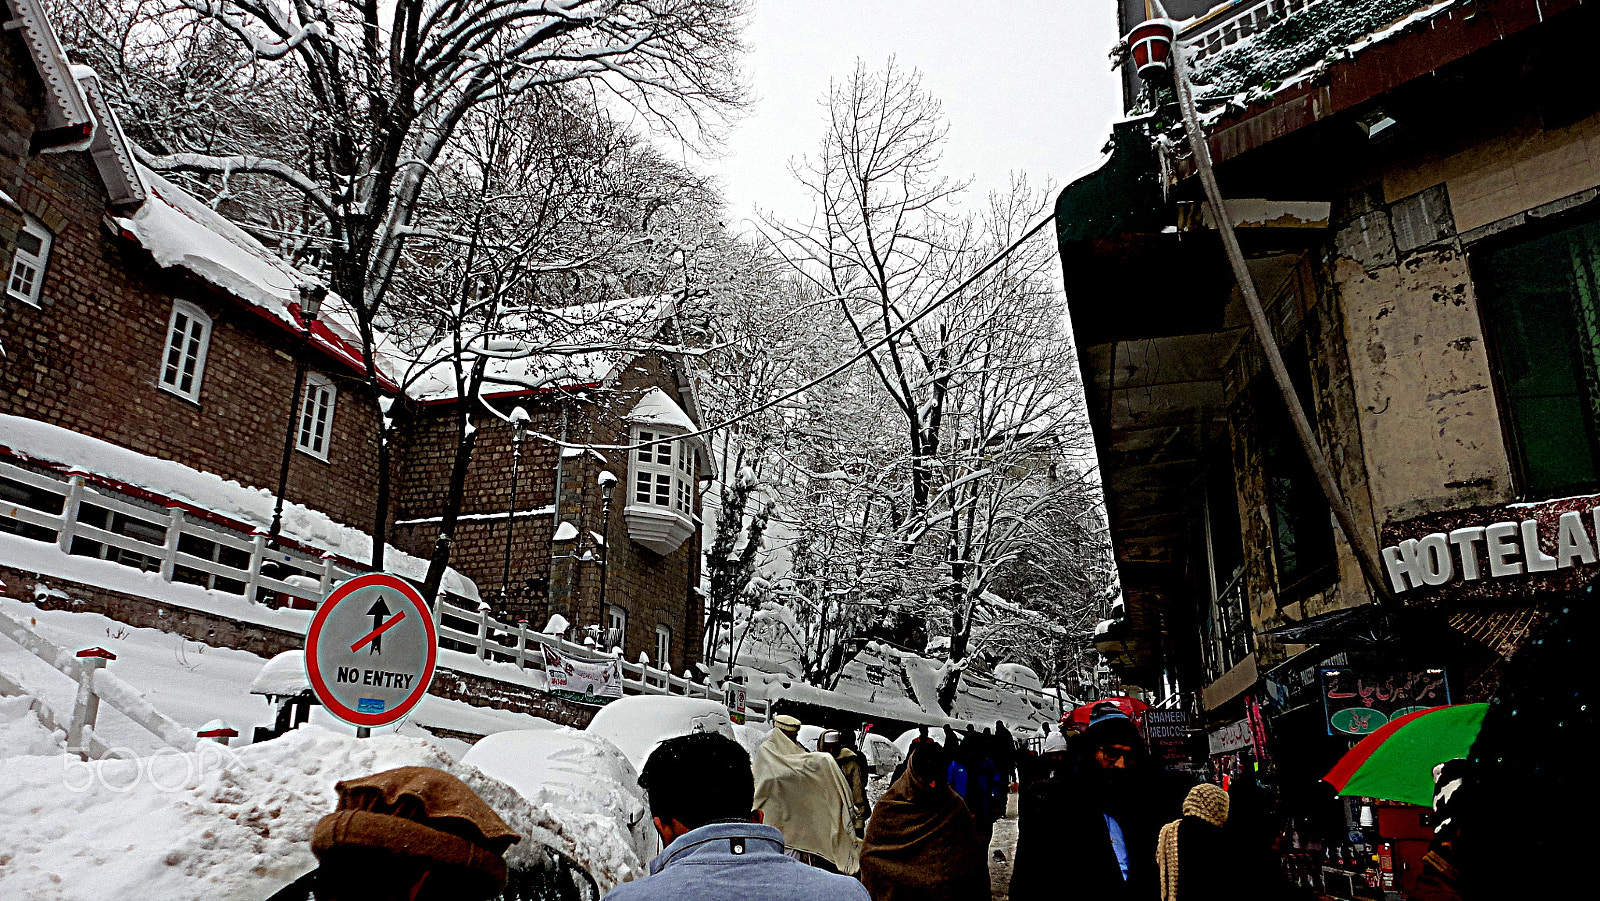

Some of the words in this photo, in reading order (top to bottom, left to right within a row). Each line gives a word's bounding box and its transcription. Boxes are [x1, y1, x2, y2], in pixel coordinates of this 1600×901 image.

[1382, 519, 1558, 594] HOTEL
[336, 666, 359, 684] NO
[363, 670, 414, 690] ENTRY
[1148, 711, 1186, 724] SHAHEEN
